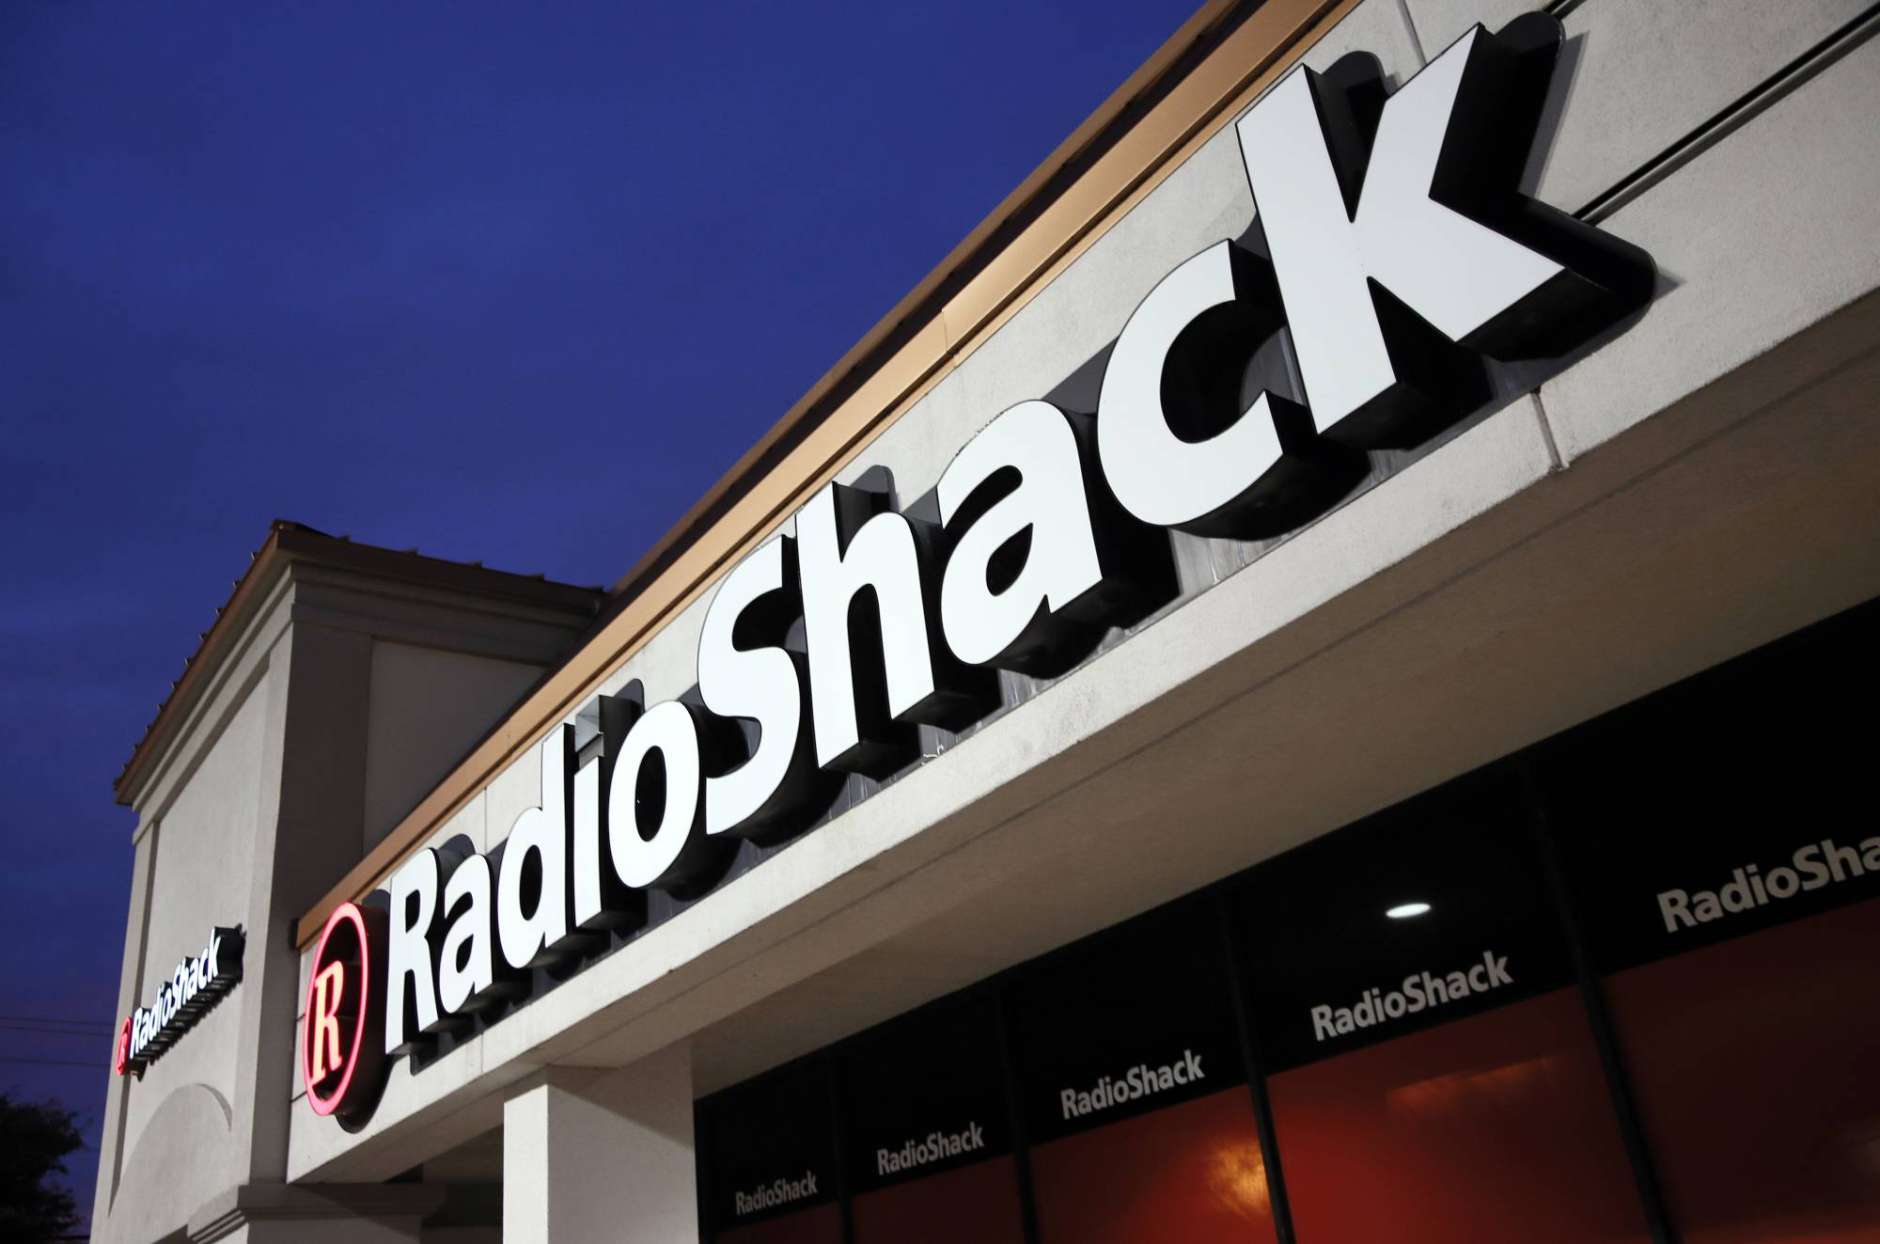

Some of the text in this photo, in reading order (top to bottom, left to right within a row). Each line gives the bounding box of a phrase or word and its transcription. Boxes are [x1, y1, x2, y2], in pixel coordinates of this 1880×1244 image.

[310, 24, 1563, 1088] R RadioShack
[129, 928, 221, 1058] RadioShack
[1311, 951, 1513, 1041] RadioShack
[1061, 1050, 1205, 1119] RadioShack
[878, 1122, 984, 1175] RadioShack
[736, 1172, 817, 1214] RadioShack
